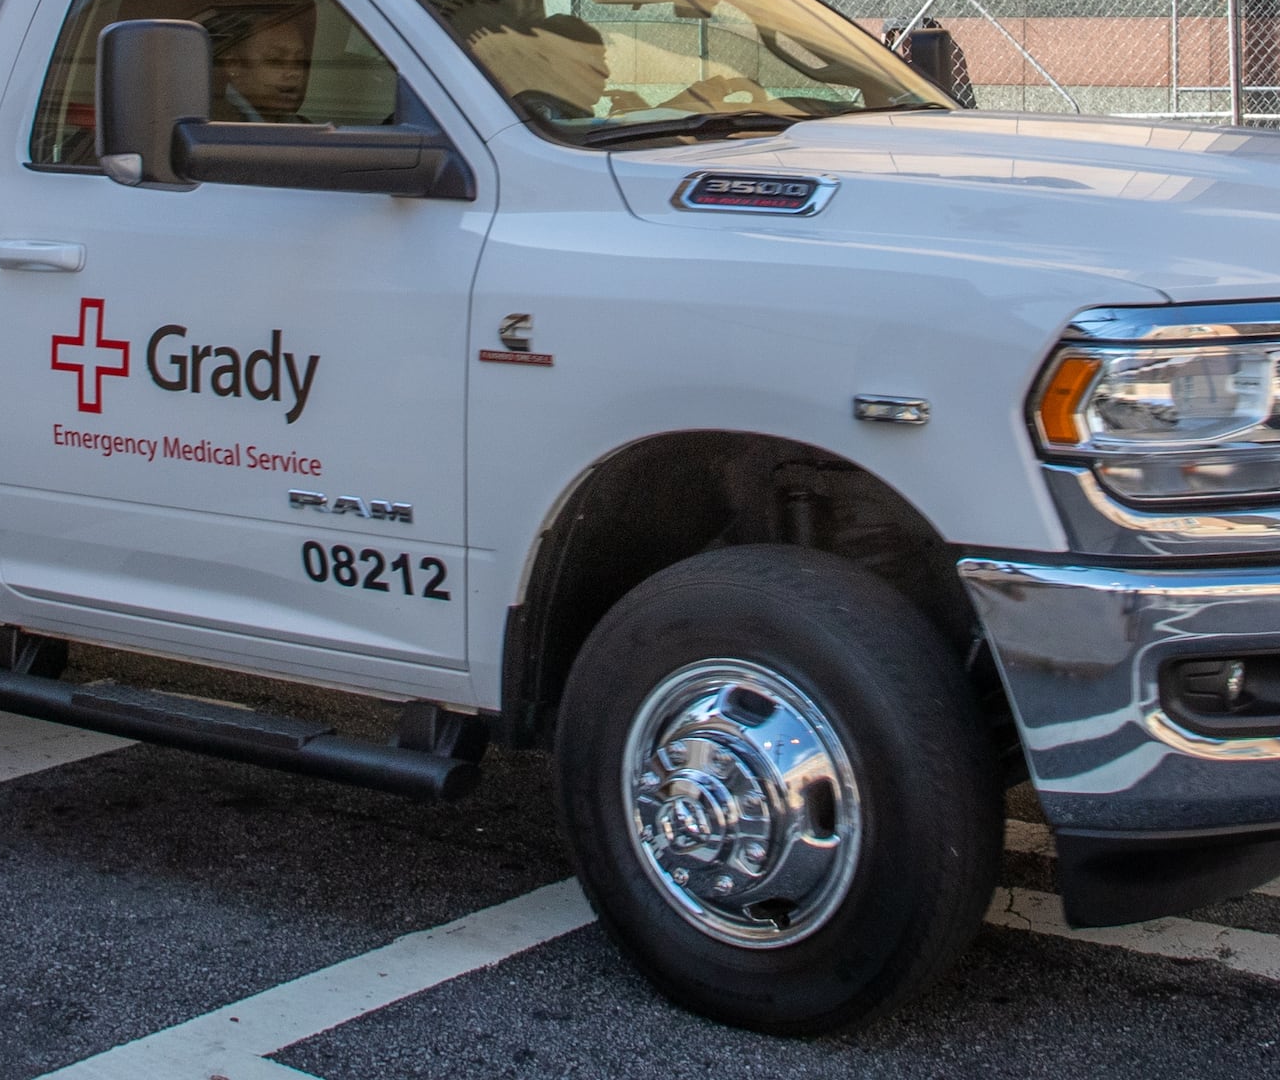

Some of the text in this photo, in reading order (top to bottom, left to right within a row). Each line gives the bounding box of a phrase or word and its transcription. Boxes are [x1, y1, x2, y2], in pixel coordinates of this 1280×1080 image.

[705, 178, 809, 198] 3500
[146, 325, 320, 424] Grady
[53, 423, 322, 477] Emergency Medical Service
[288, 489, 414, 524] RAM
[302, 540, 451, 601] 08212
